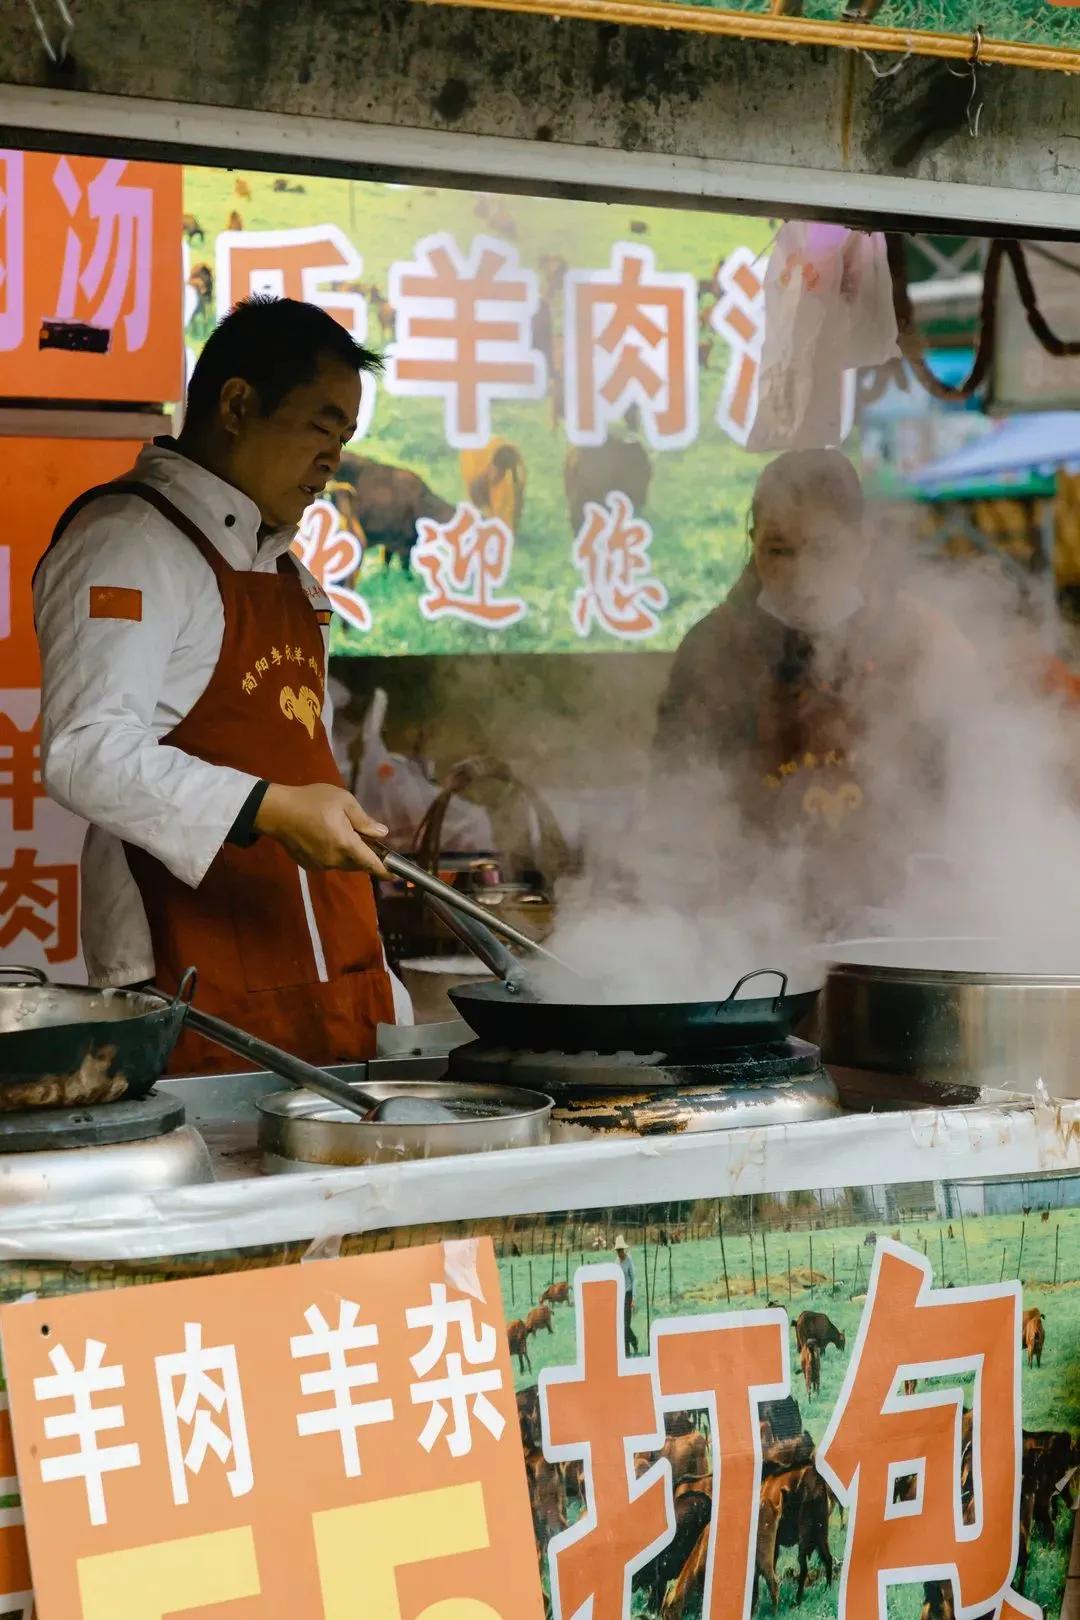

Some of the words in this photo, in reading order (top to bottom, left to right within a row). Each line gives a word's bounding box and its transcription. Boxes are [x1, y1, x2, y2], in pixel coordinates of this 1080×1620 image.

[34, 1322, 254, 1526] 羊肉
[290, 1283, 506, 1478] 羊杂
[538, 1236, 1046, 1620] 打包
